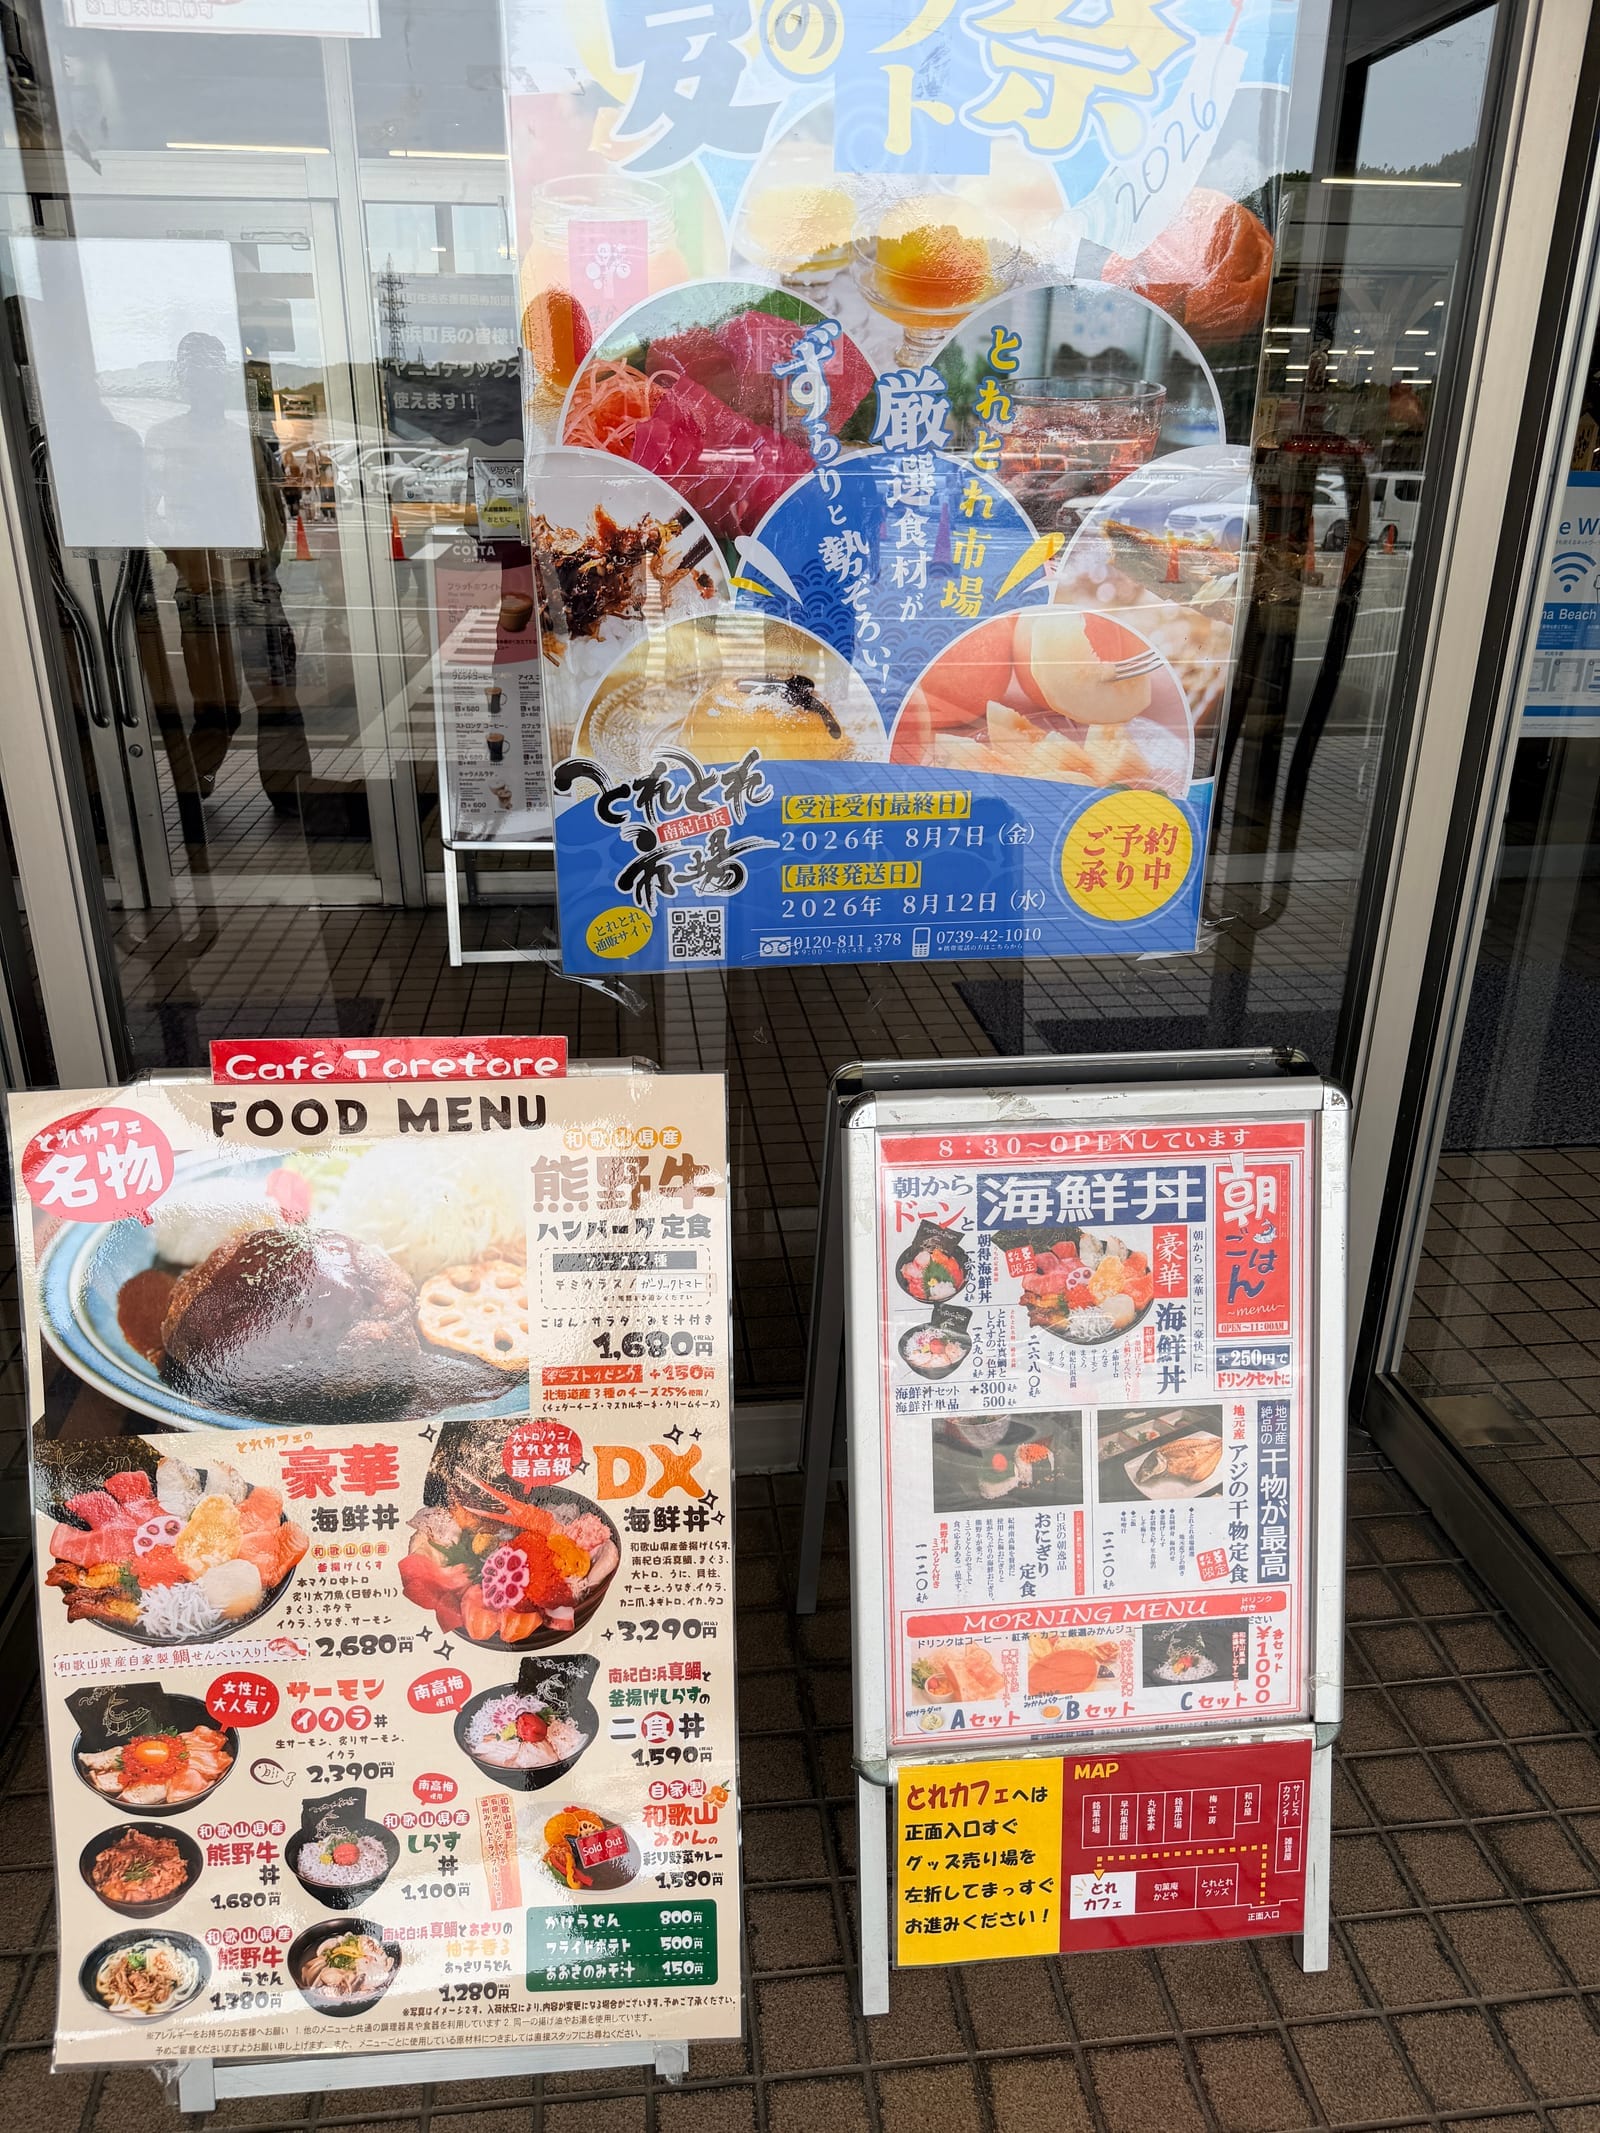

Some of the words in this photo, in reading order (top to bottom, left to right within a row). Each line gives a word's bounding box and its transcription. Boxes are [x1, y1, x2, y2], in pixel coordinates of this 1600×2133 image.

[1114, 93, 1221, 225] 2026
[939, 325, 1022, 619] とれとれ市場
[872, 366, 953, 624] 厳選食材が
[452, 545, 496, 556] COSTA
[1559, 608, 1597, 620] Beach
[661, 811, 728, 842] 南紀白浜
[782, 827, 884, 851] 2026年
[1083, 822, 1179, 858] ご予約
[1076, 860, 1171, 893] 承り中
[782, 893, 882, 919] 2026年
[594, 911, 643, 938] とれとれ
[936, 928, 1042, 945] 0739-42-1010
[592, 923, 652, 954] 通販サイト
[225, 1051, 335, 1081] Café
[344, 1049, 560, 1080] Toretore
[210, 1098, 369, 1138] FOOD
[397, 1094, 548, 1134] MENU
[34, 1118, 143, 1154] とれカフェ
[563, 1126, 683, 1151] 和歌山県産
[34, 1140, 164, 1208] 名物
[531, 1153, 717, 1213] 熊野牛
[891, 1174, 974, 1199] 朝から
[981, 1170, 1204, 1226] 海鮮丼
[536, 1214, 712, 1242] ハンバーグ定食
[894, 1199, 975, 1233] ドーンと
[977, 1233, 992, 1304] 朝得海鮮丼
[1156, 1232, 1184, 1293] 豪華
[592, 1331, 713, 1361] 1,680円
[1157, 1302, 1187, 1395] 海鮮丼
[1217, 1370, 1291, 1388] ドリンクセットに
[896, 1386, 960, 1400] 海鮮汁セット
[896, 1398, 960, 1413] 海鮮汁単品
[1232, 1404, 1245, 1440] 地元産
[512, 1442, 570, 1457] とれとれ
[279, 1442, 400, 1499] 豪華
[511, 1458, 573, 1478] 最高級
[593, 1443, 706, 1500] DX
[311, 1503, 400, 1533] 海鮮丼
[623, 1505, 710, 1533] 海鮮丼
[1228, 1444, 1249, 1584] アジの干物定食
[1260, 1448, 1289, 1578] 干物が最高
[311, 1542, 390, 1559] 和歌山県産
[1034, 1512, 1052, 1578] おにぎり
[297, 1576, 370, 1587] 本マグロ中トロ
[1019, 1563, 1037, 1598] 定食
[963, 1606, 1113, 1632] MORNING
[1123, 1600, 1209, 1620] MENU
[617, 1618, 718, 1643] 3,290円
[315, 1634, 413, 1659] 2,680円
[608, 1661, 712, 1684] 南紀白浜真鯛と
[222, 1680, 267, 1697] 女性に
[286, 1677, 385, 1704] サーモン
[412, 1674, 465, 1700] 南高梅
[608, 1686, 711, 1708] 釜揚げしらすの
[212, 1698, 272, 1716] 大人気!
[326, 1749, 356, 1760] イクラ
[631, 1746, 713, 1767] 1,590円
[305, 1762, 395, 1784] 2,390円
[1073, 1762, 1120, 1780] MAP
[417, 1779, 455, 1794] 南高梅
[648, 1778, 707, 1800] 自家製
[906, 1779, 1048, 1811] とれカフェへは
[1207, 1794, 1218, 1825] 梅工房
[1243, 1791, 1253, 1816] 和か屋
[1282, 1785, 1291, 1825] カウンター
[1291, 1784, 1301, 1816] サービス
[382, 1809, 470, 1830] 和歌山県産
[642, 1802, 718, 1828] 和歌山
[197, 1819, 286, 1841] 和歌山県産
[408, 1831, 461, 1853] しらす
[653, 1829, 718, 1846] みかんの
[904, 1818, 1019, 1842] 正面入口すぐ
[206, 1840, 281, 1867] 熊野牛
[582, 1841, 603, 1858] Sold
[604, 1836, 623, 1849] Out
[643, 1850, 724, 1866] 彩り野菜カレー
[906, 1848, 1036, 1871] グッズ売り場を
[259, 1864, 281, 1886] 丼
[438, 1855, 459, 1876] 丼
[904, 1877, 1055, 1903] 左折してまっすぐ
[1090, 1881, 1118, 1895] とれ
[1153, 1891, 1179, 1901] かどや
[1201, 1878, 1234, 1889] とれとれ
[1204, 1887, 1230, 1897] グッズ
[1083, 1897, 1122, 1912] カフェ
[1247, 1910, 1280, 1921] 正面入口
[544, 1913, 621, 1930] かけうどん
[659, 1910, 703, 1925] 800円
[904, 1908, 1050, 1935] お進みください!
[205, 1924, 293, 1946] 和歌山県産
[546, 1937, 631, 1955] フライドポテト
[659, 1935, 703, 1951] 500円
[217, 1945, 284, 1971] 熊野牛
[446, 1939, 511, 1958] 柚子香る
[240, 1971, 284, 1987] うどん
[445, 1959, 513, 1974] あっさりうどん
[546, 1961, 636, 1981] あおさのみそ汁
[661, 1960, 703, 1976] 150円
